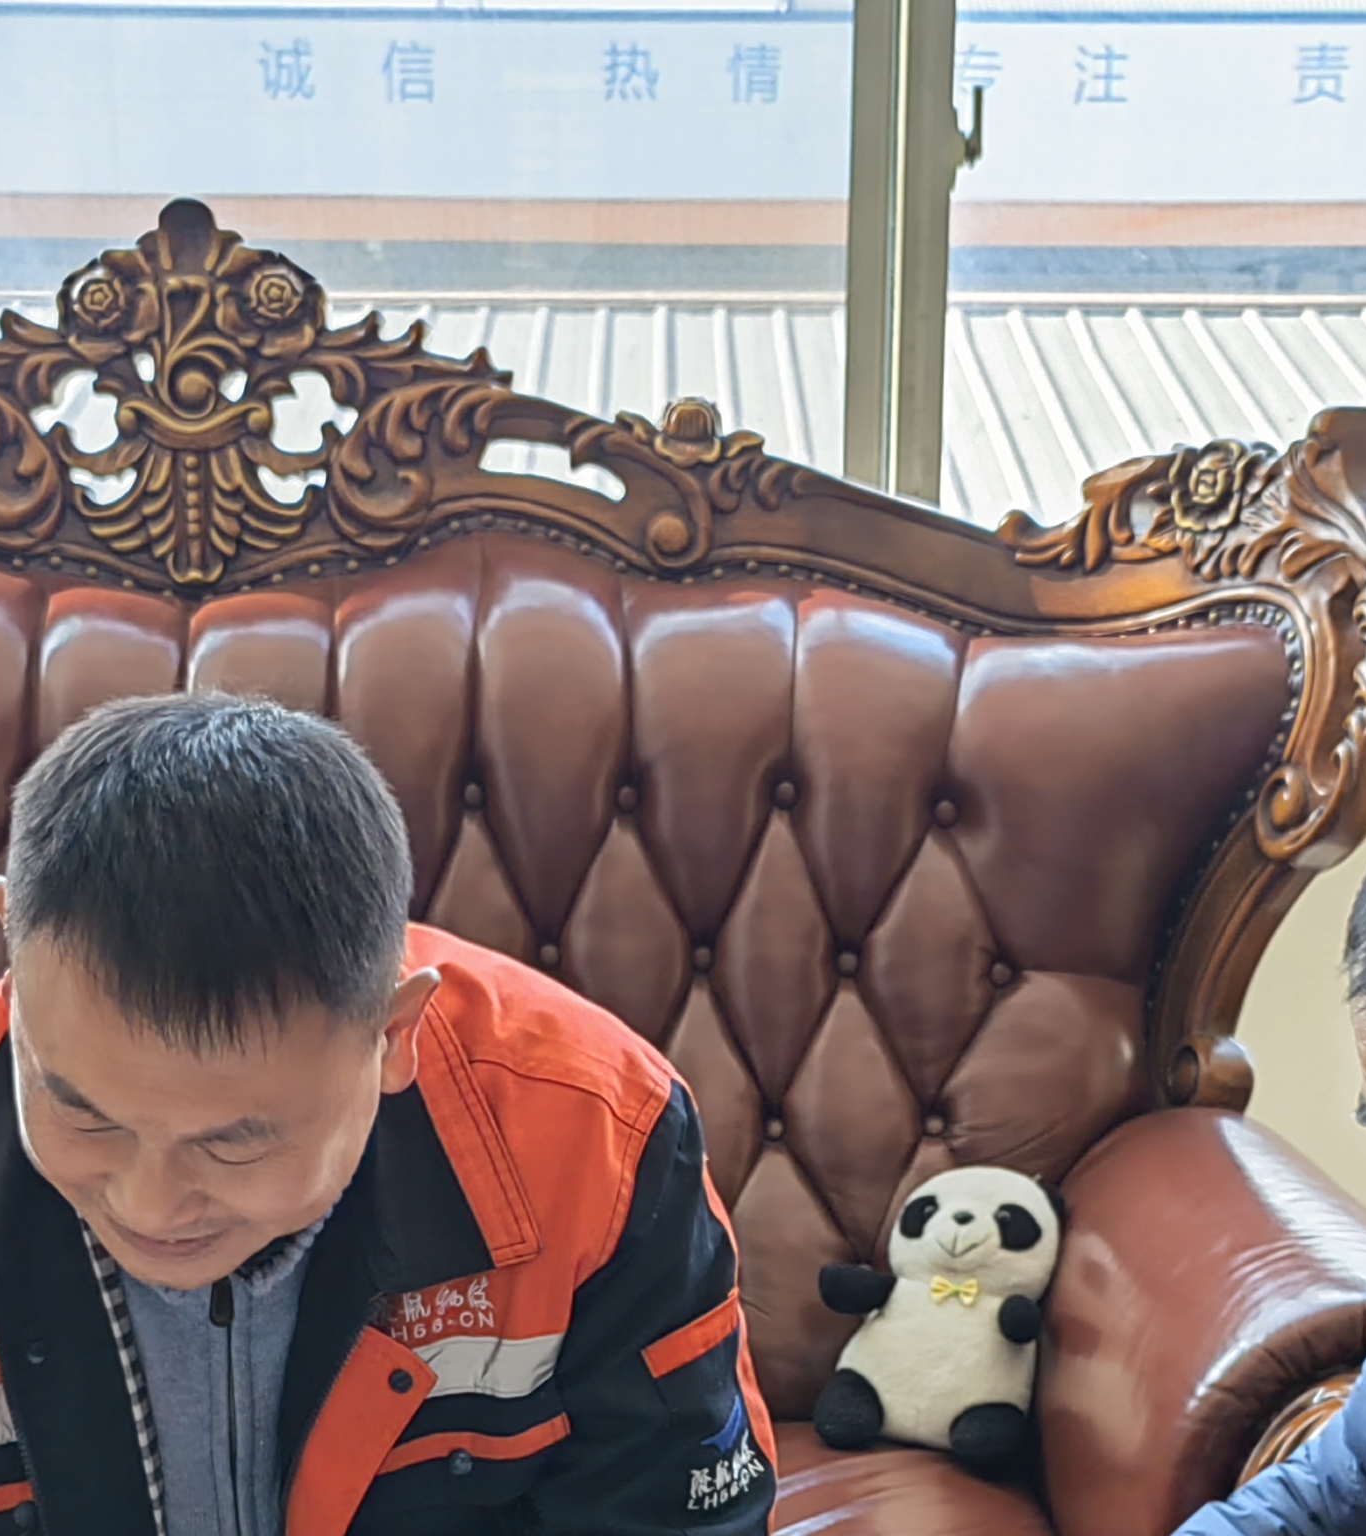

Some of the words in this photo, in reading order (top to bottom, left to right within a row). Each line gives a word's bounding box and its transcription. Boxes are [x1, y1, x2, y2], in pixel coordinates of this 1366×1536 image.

[258, 38, 436, 103] 诚信
[603, 42, 782, 104] 热情
[956, 43, 1129, 104] 专注
